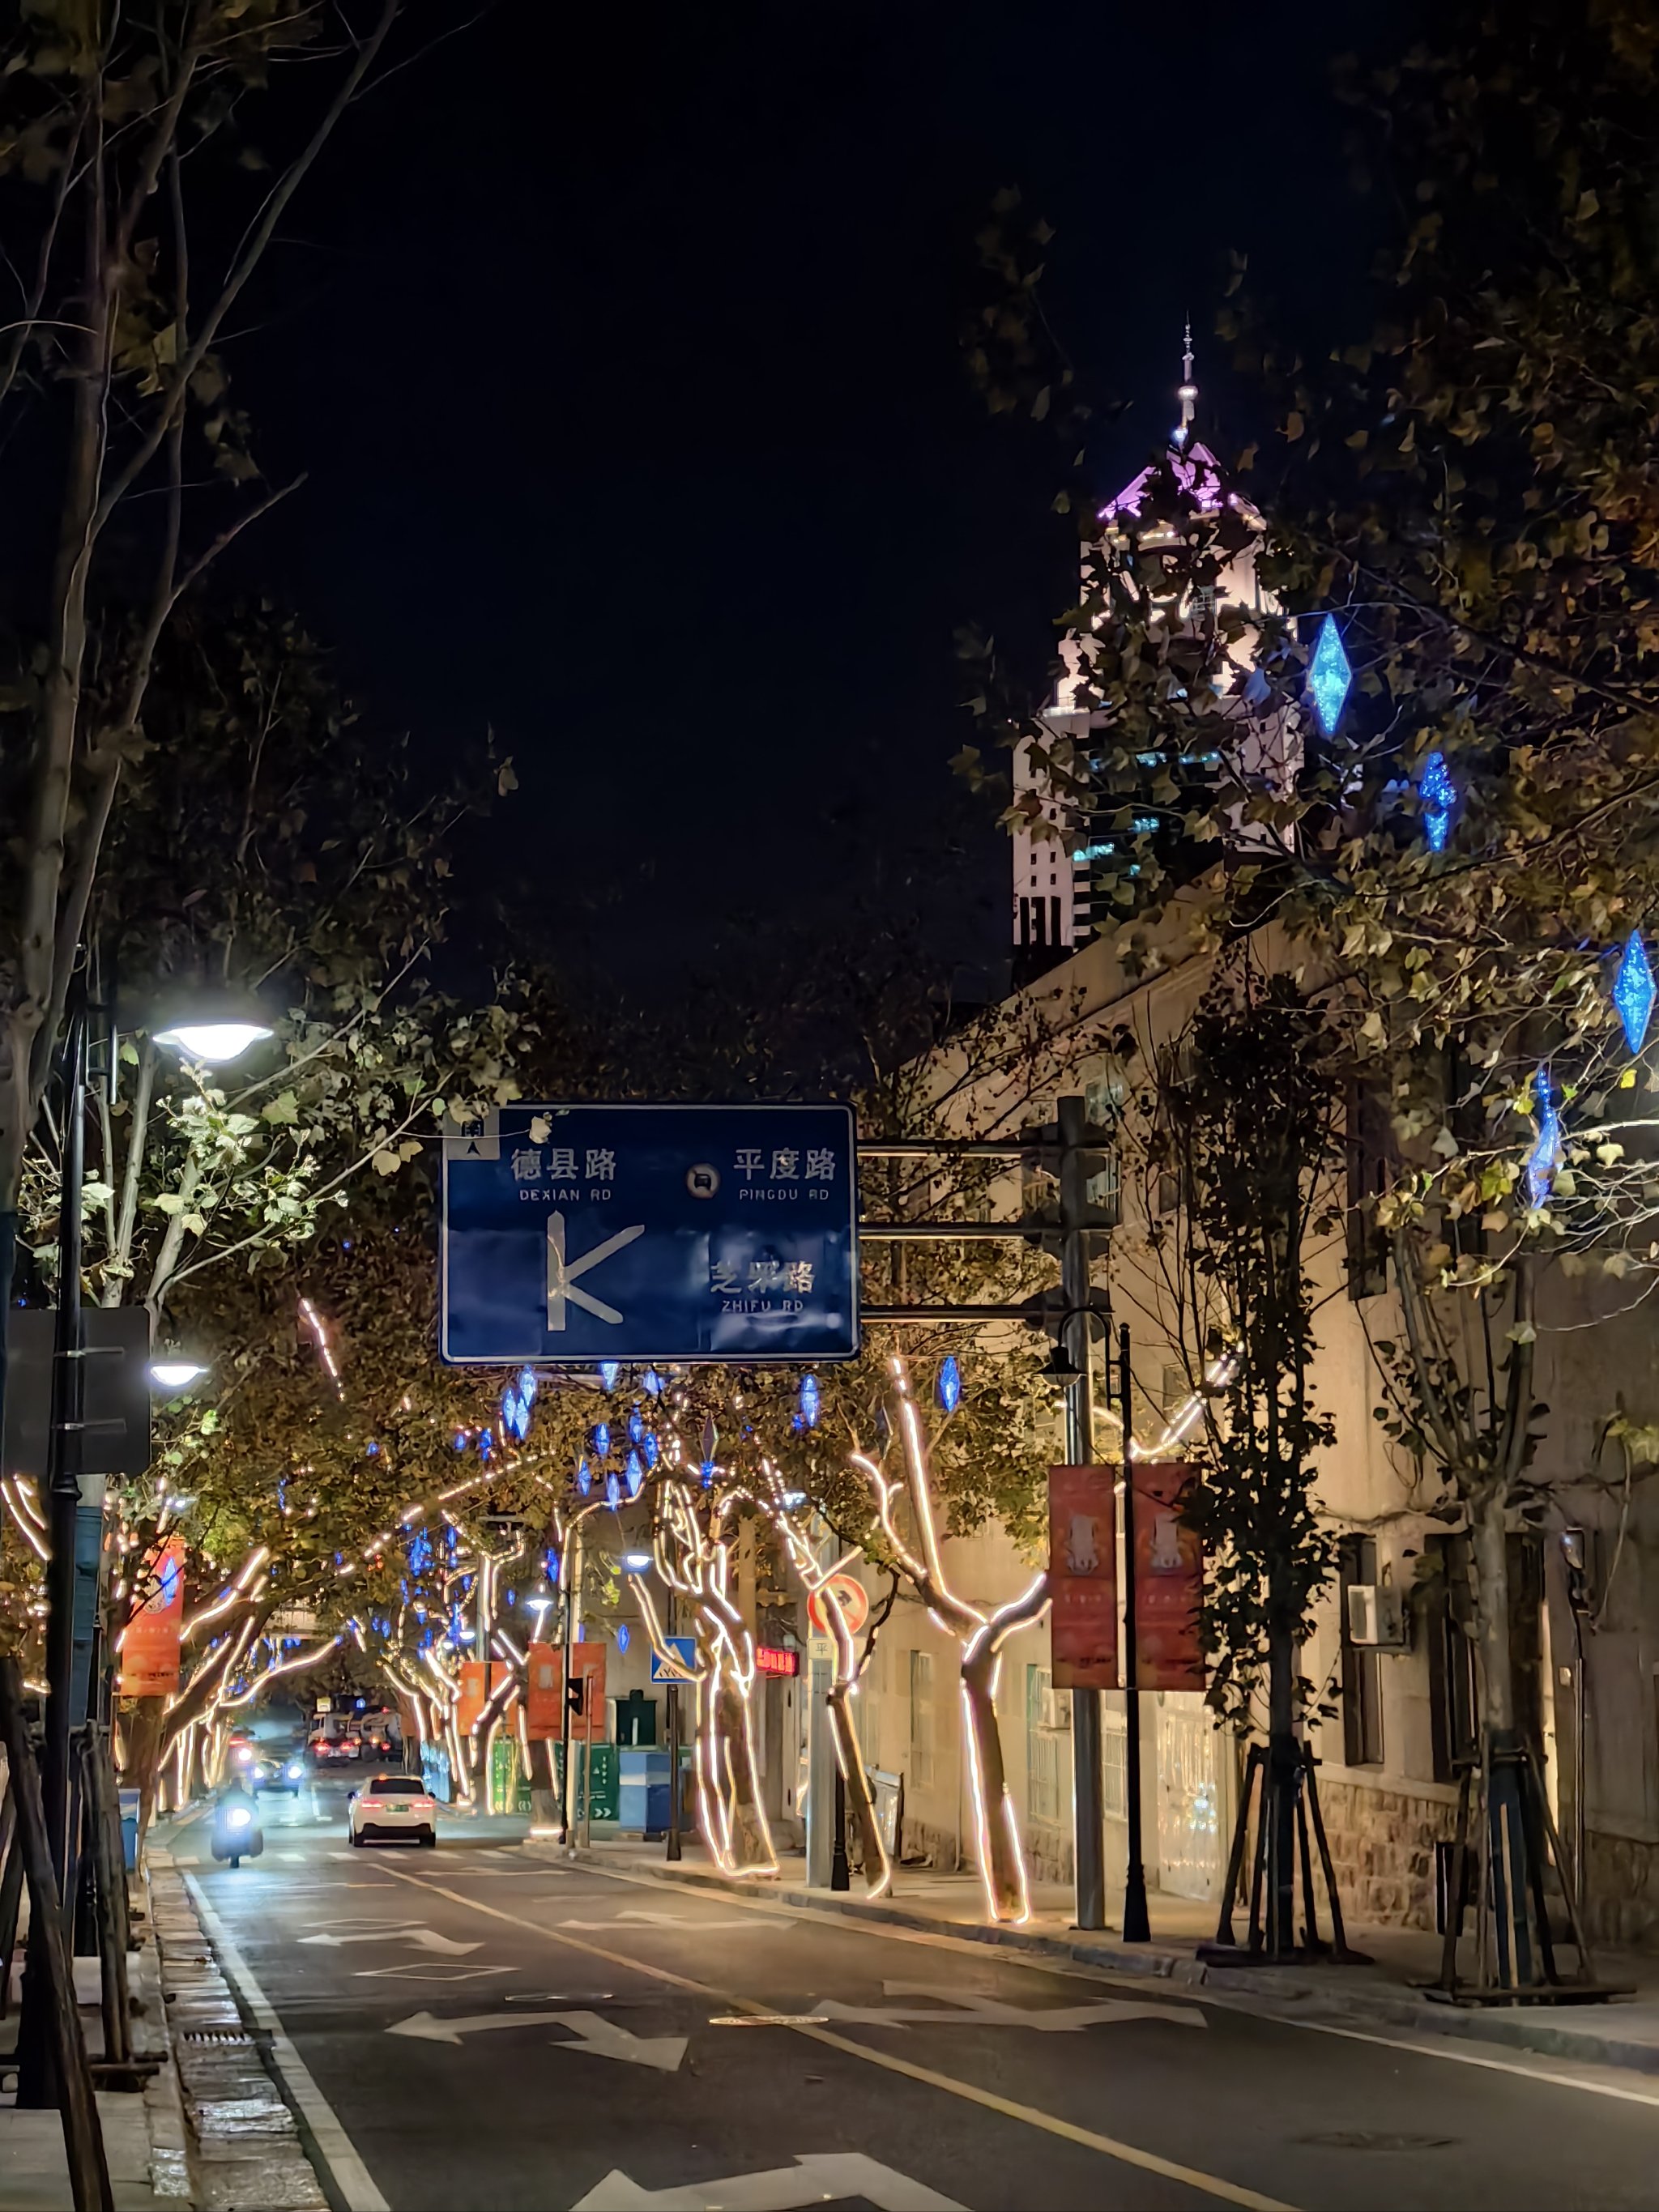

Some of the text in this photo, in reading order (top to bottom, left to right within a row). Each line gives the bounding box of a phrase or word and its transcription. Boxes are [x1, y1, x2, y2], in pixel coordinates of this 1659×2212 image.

[511, 1149, 616, 1181] 德县路
[733, 1148, 836, 1180] 平度路
[519, 1189, 612, 1201] DEXIAN RD
[740, 1188, 829, 1200] PINGDU RD
[722, 1300, 804, 1313] ZHIFU RD
